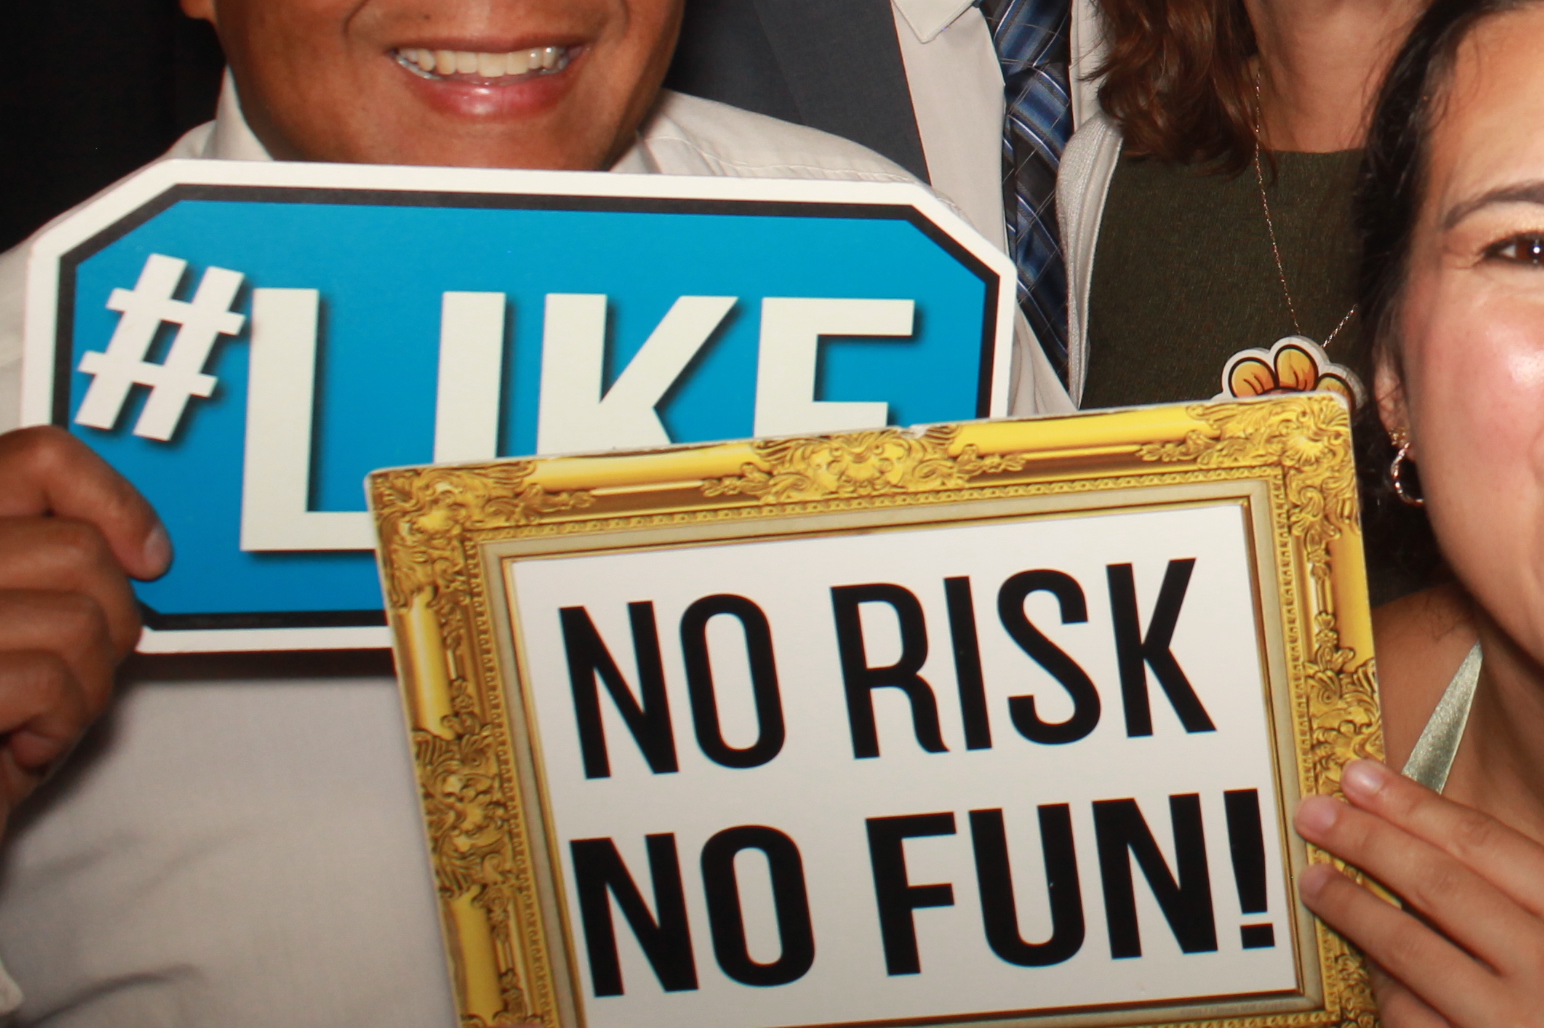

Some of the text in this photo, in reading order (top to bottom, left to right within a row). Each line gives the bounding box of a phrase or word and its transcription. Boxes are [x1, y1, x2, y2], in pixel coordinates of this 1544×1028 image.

[559, 558, 1216, 780] NO RISK
[569, 788, 1276, 998] NO FUN!
